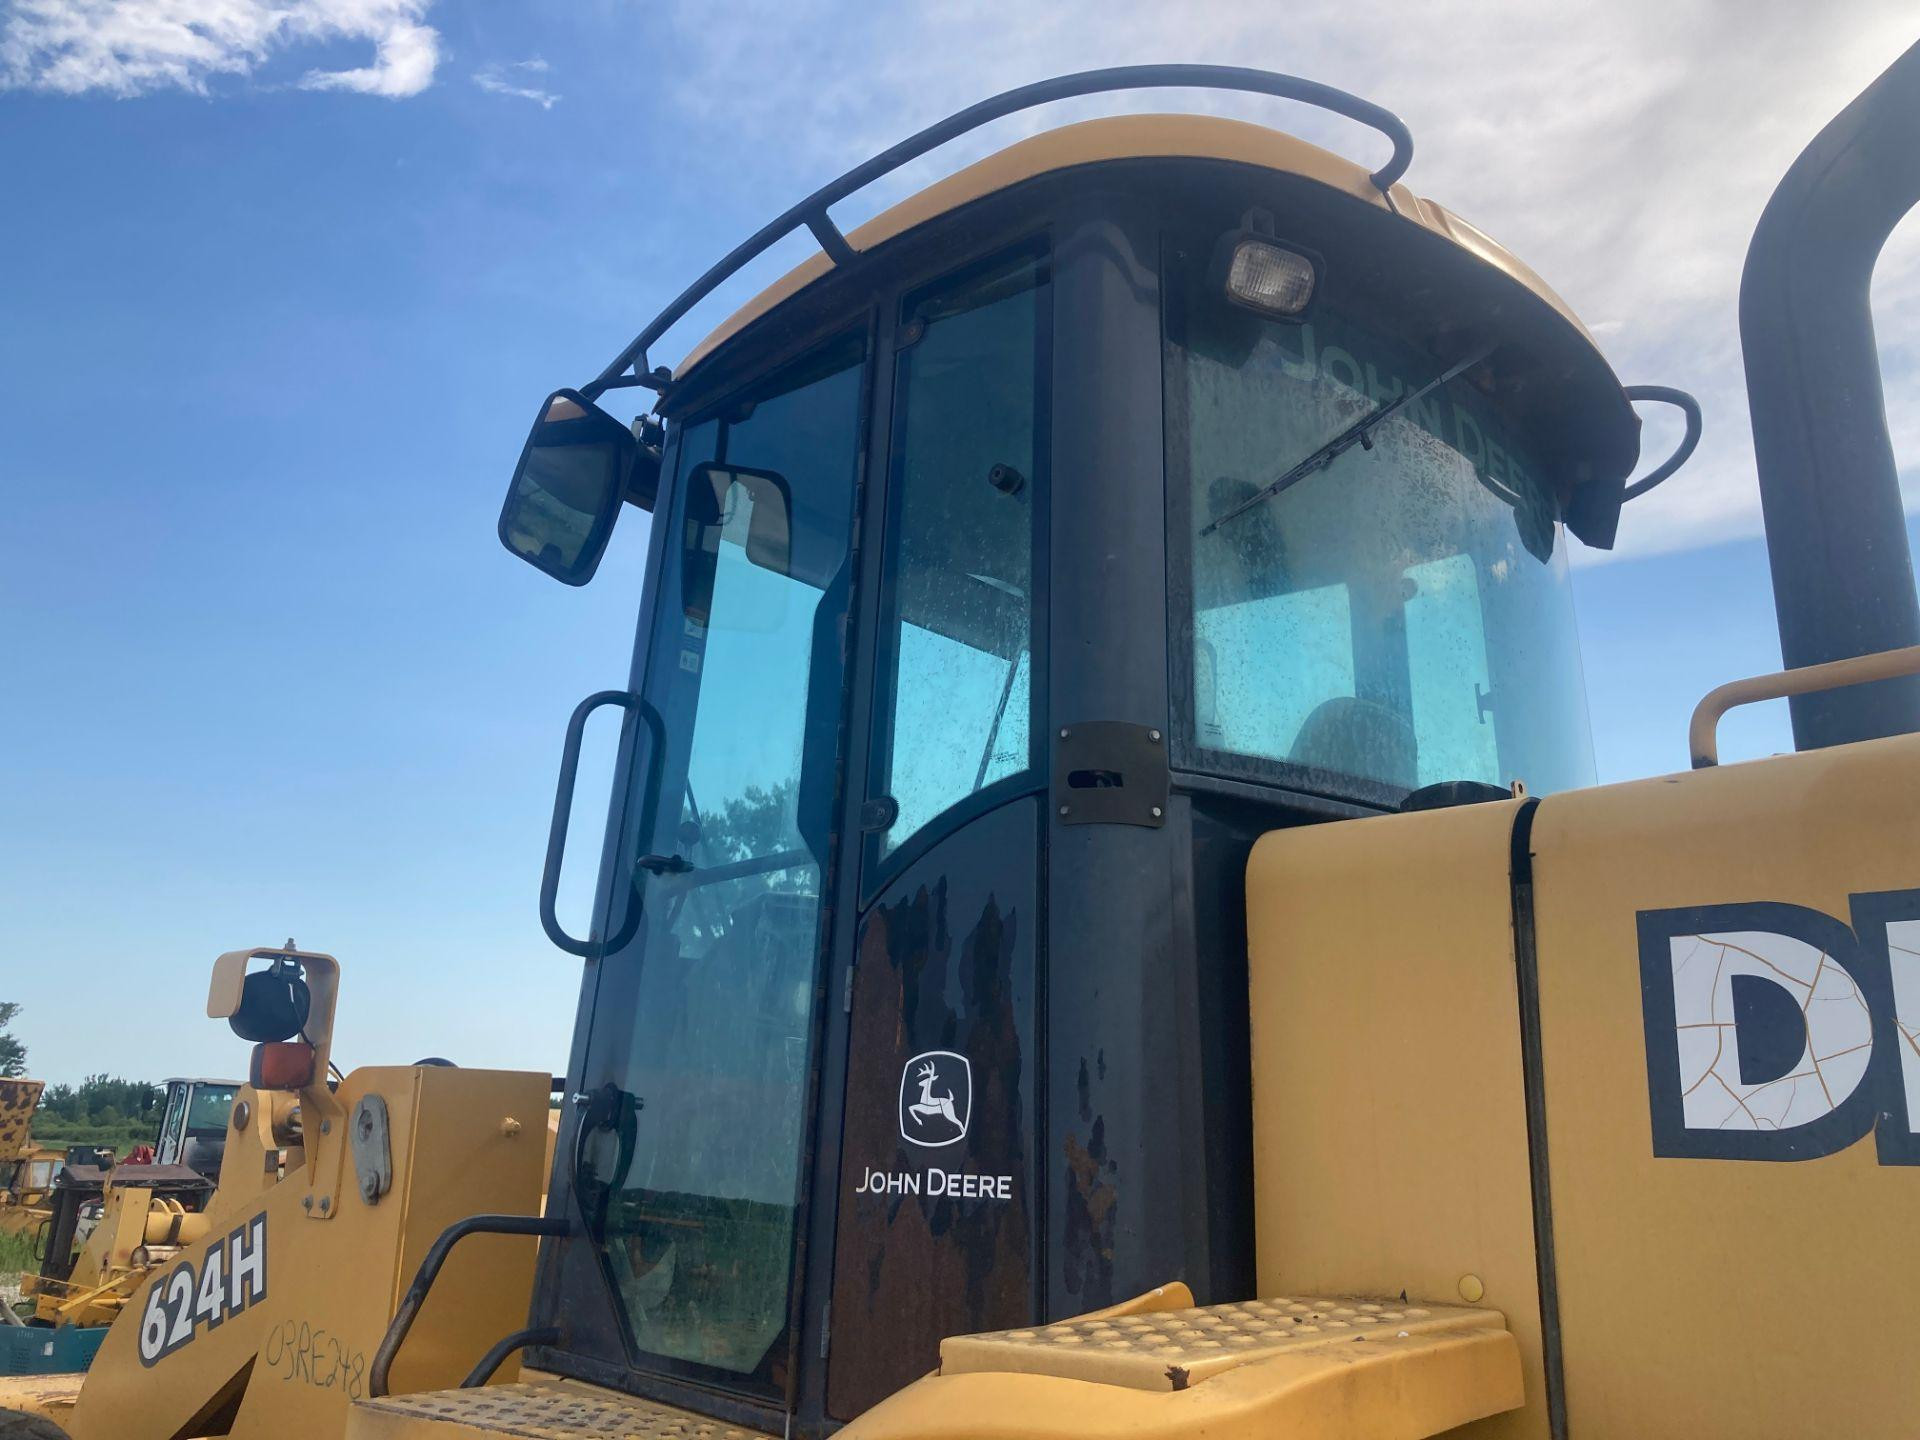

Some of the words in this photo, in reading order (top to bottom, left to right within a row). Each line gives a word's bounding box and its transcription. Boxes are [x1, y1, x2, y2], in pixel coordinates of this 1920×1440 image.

[855, 1166, 921, 1196] JOHN
[926, 1168, 1013, 1200] DEERE
[139, 1216, 266, 1364] 624H
